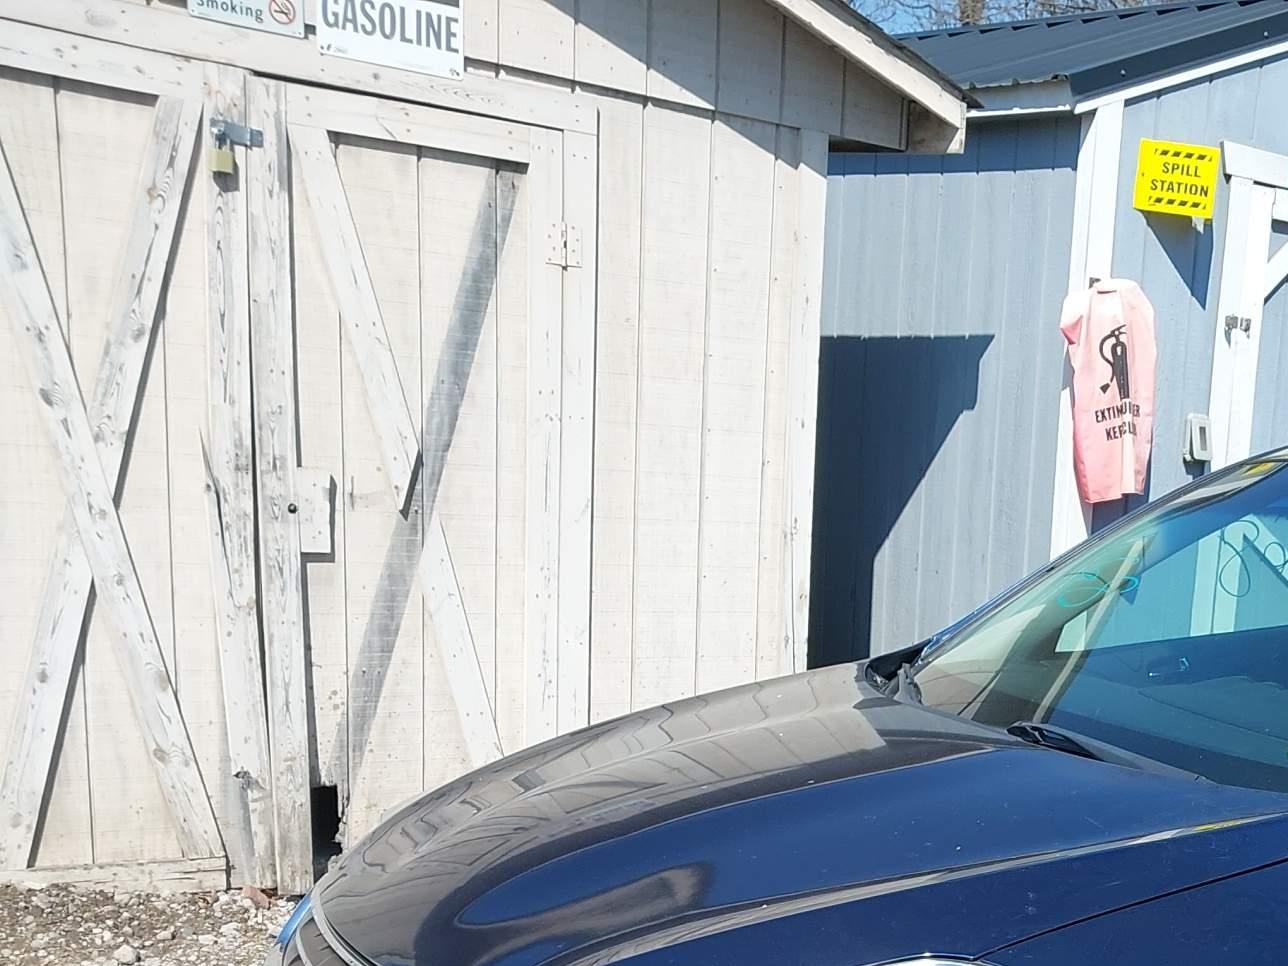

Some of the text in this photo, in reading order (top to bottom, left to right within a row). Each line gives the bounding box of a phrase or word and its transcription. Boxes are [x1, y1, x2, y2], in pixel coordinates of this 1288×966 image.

[321, 0, 459, 54] GASOLINE
[1162, 162, 1201, 178] SPILL
[1150, 179, 1209, 197] STATION
